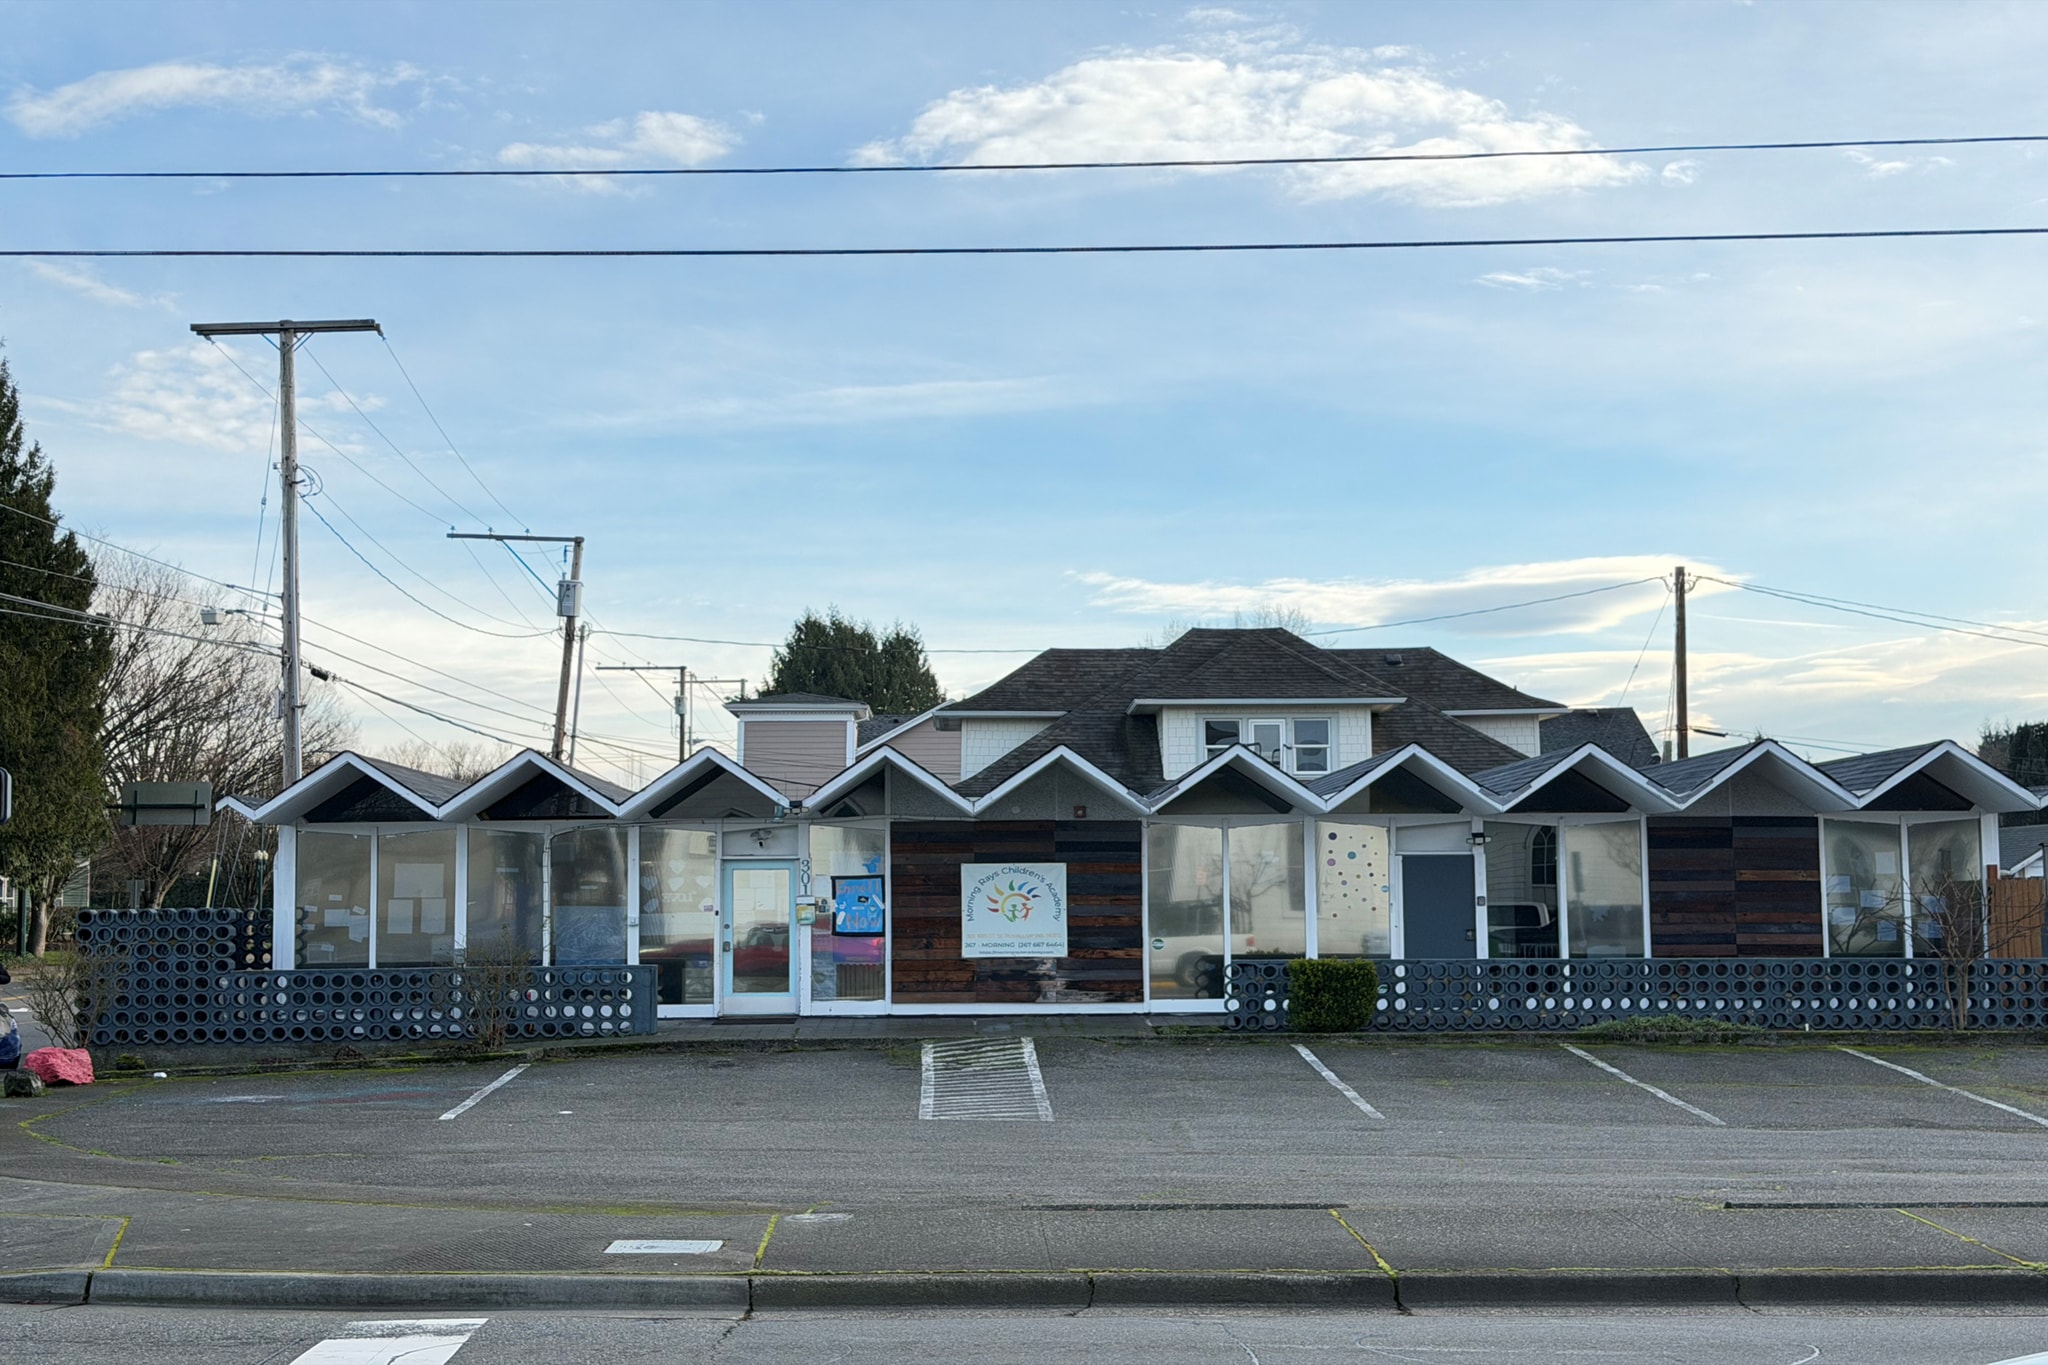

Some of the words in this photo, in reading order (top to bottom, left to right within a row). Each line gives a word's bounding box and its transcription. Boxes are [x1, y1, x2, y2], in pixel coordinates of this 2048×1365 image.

[801, 859, 810, 896] 301
[836, 880, 880, 894] Enroll
[966, 886, 981, 922] Morning
[978, 871, 1000, 886] Rays
[1001, 866, 1046, 883] Children's
[1046, 882, 1062, 922] Academy
[846, 912, 882, 930] Now
